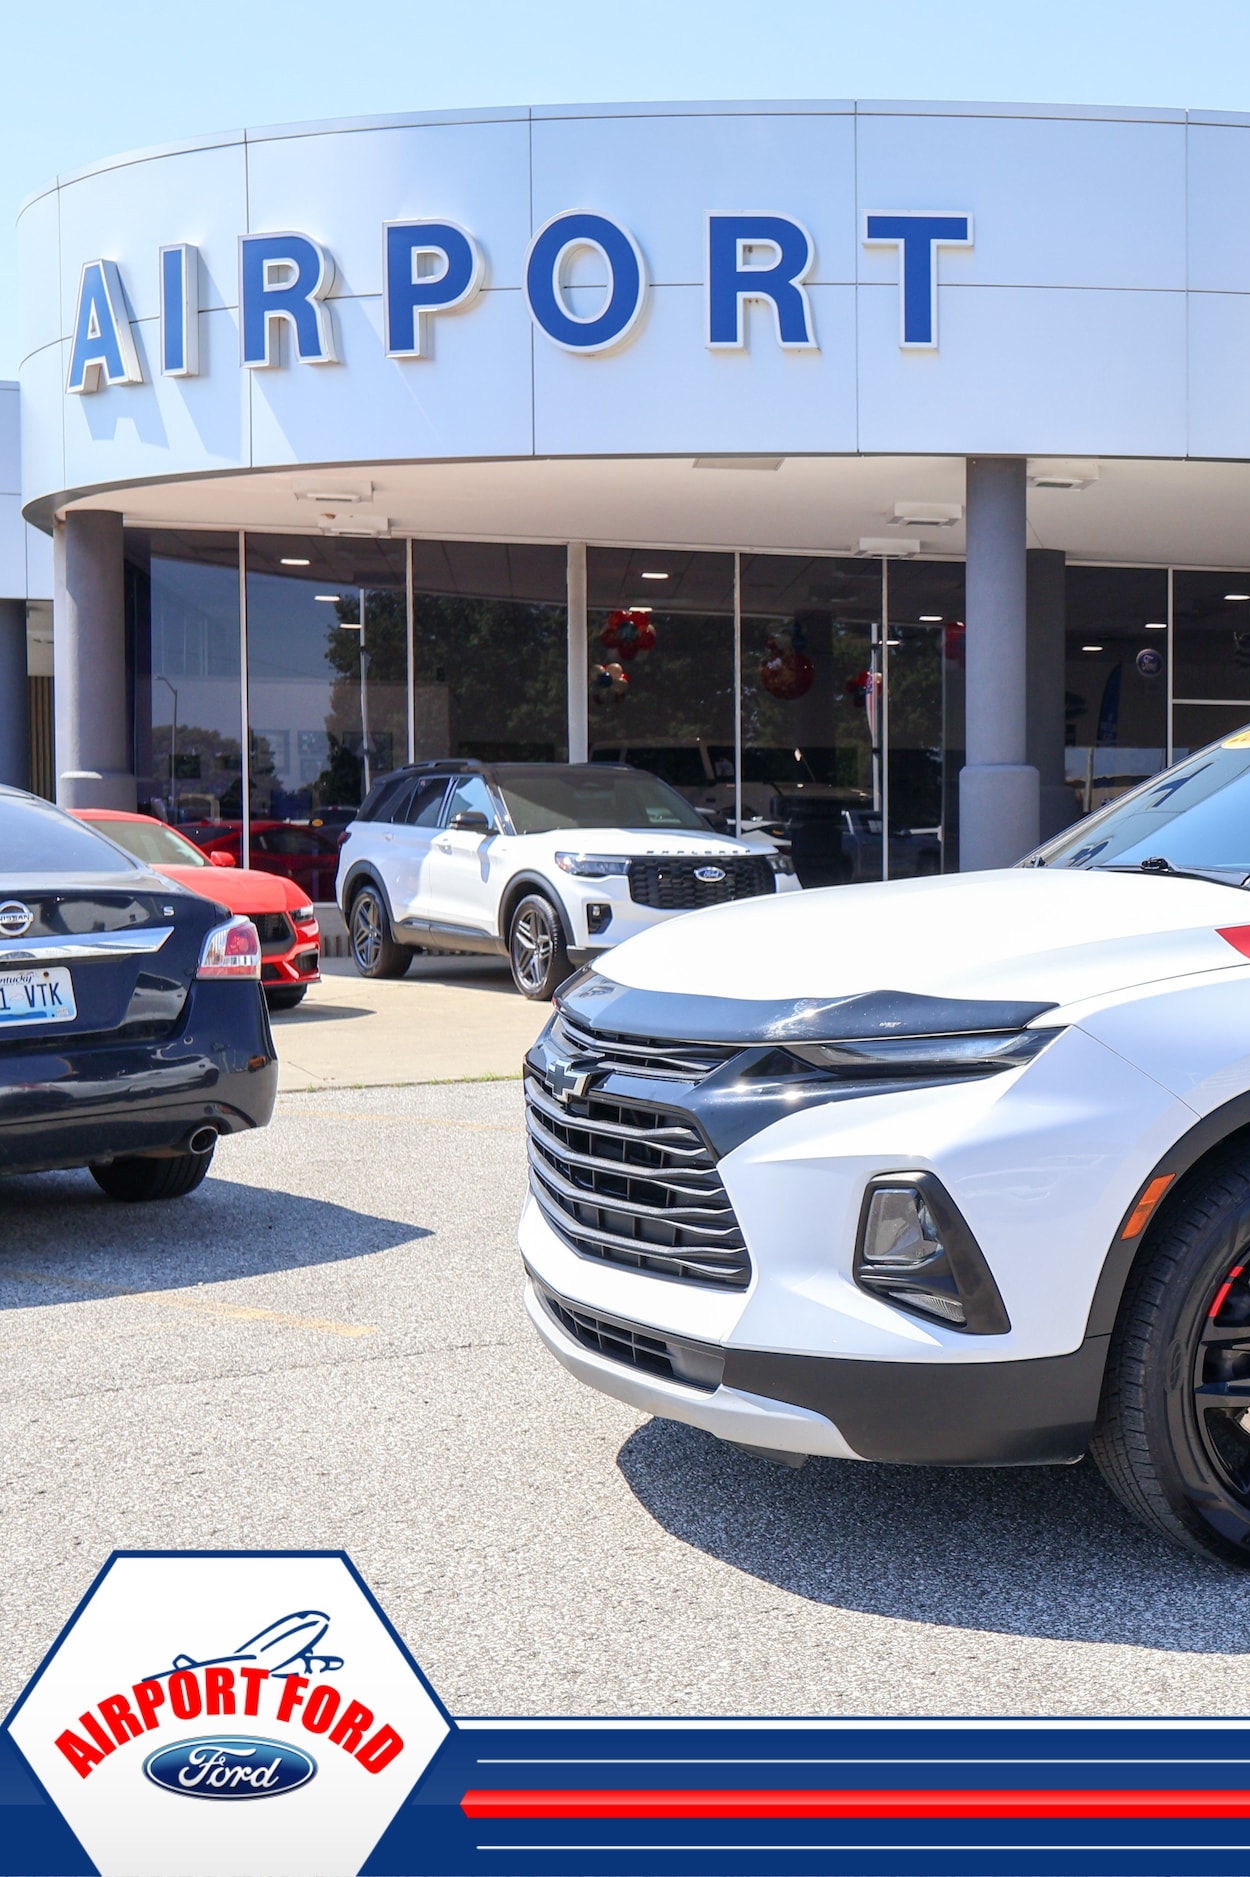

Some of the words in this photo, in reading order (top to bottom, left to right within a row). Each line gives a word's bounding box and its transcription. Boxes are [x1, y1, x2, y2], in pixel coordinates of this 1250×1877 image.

[66, 208, 975, 395] AIRPORT
[163, 905, 175, 917] S
[0, 974, 34, 985] ntucky
[24, 982, 63, 1009] VTK
